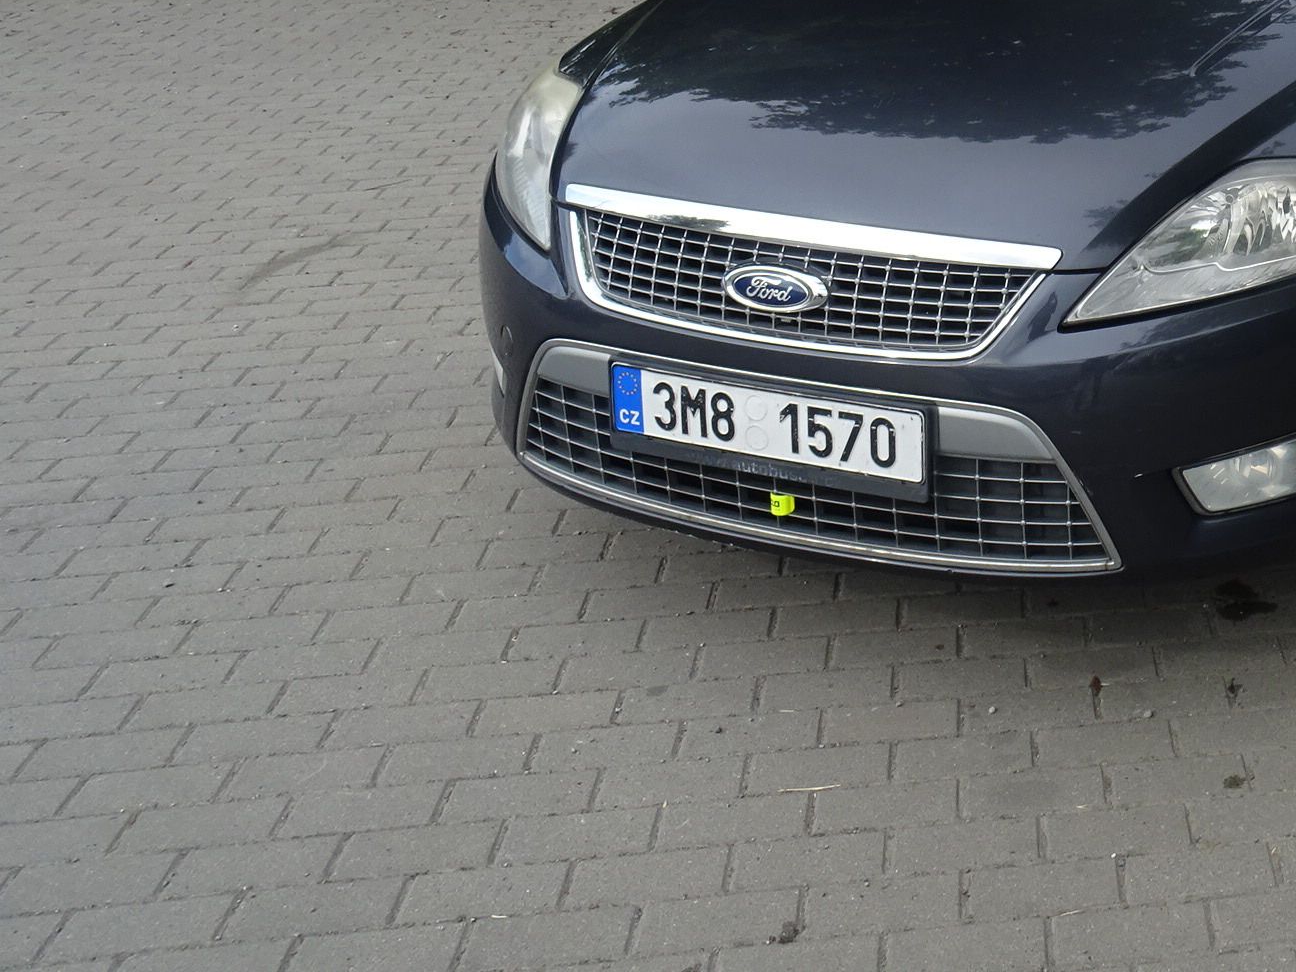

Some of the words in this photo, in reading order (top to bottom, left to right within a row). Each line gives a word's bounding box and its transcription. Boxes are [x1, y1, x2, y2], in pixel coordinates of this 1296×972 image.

[746, 276, 793, 302] Ford
[619, 408, 641, 426] CZ
[652, 381, 735, 442] 3M8
[779, 402, 897, 468] 1570
